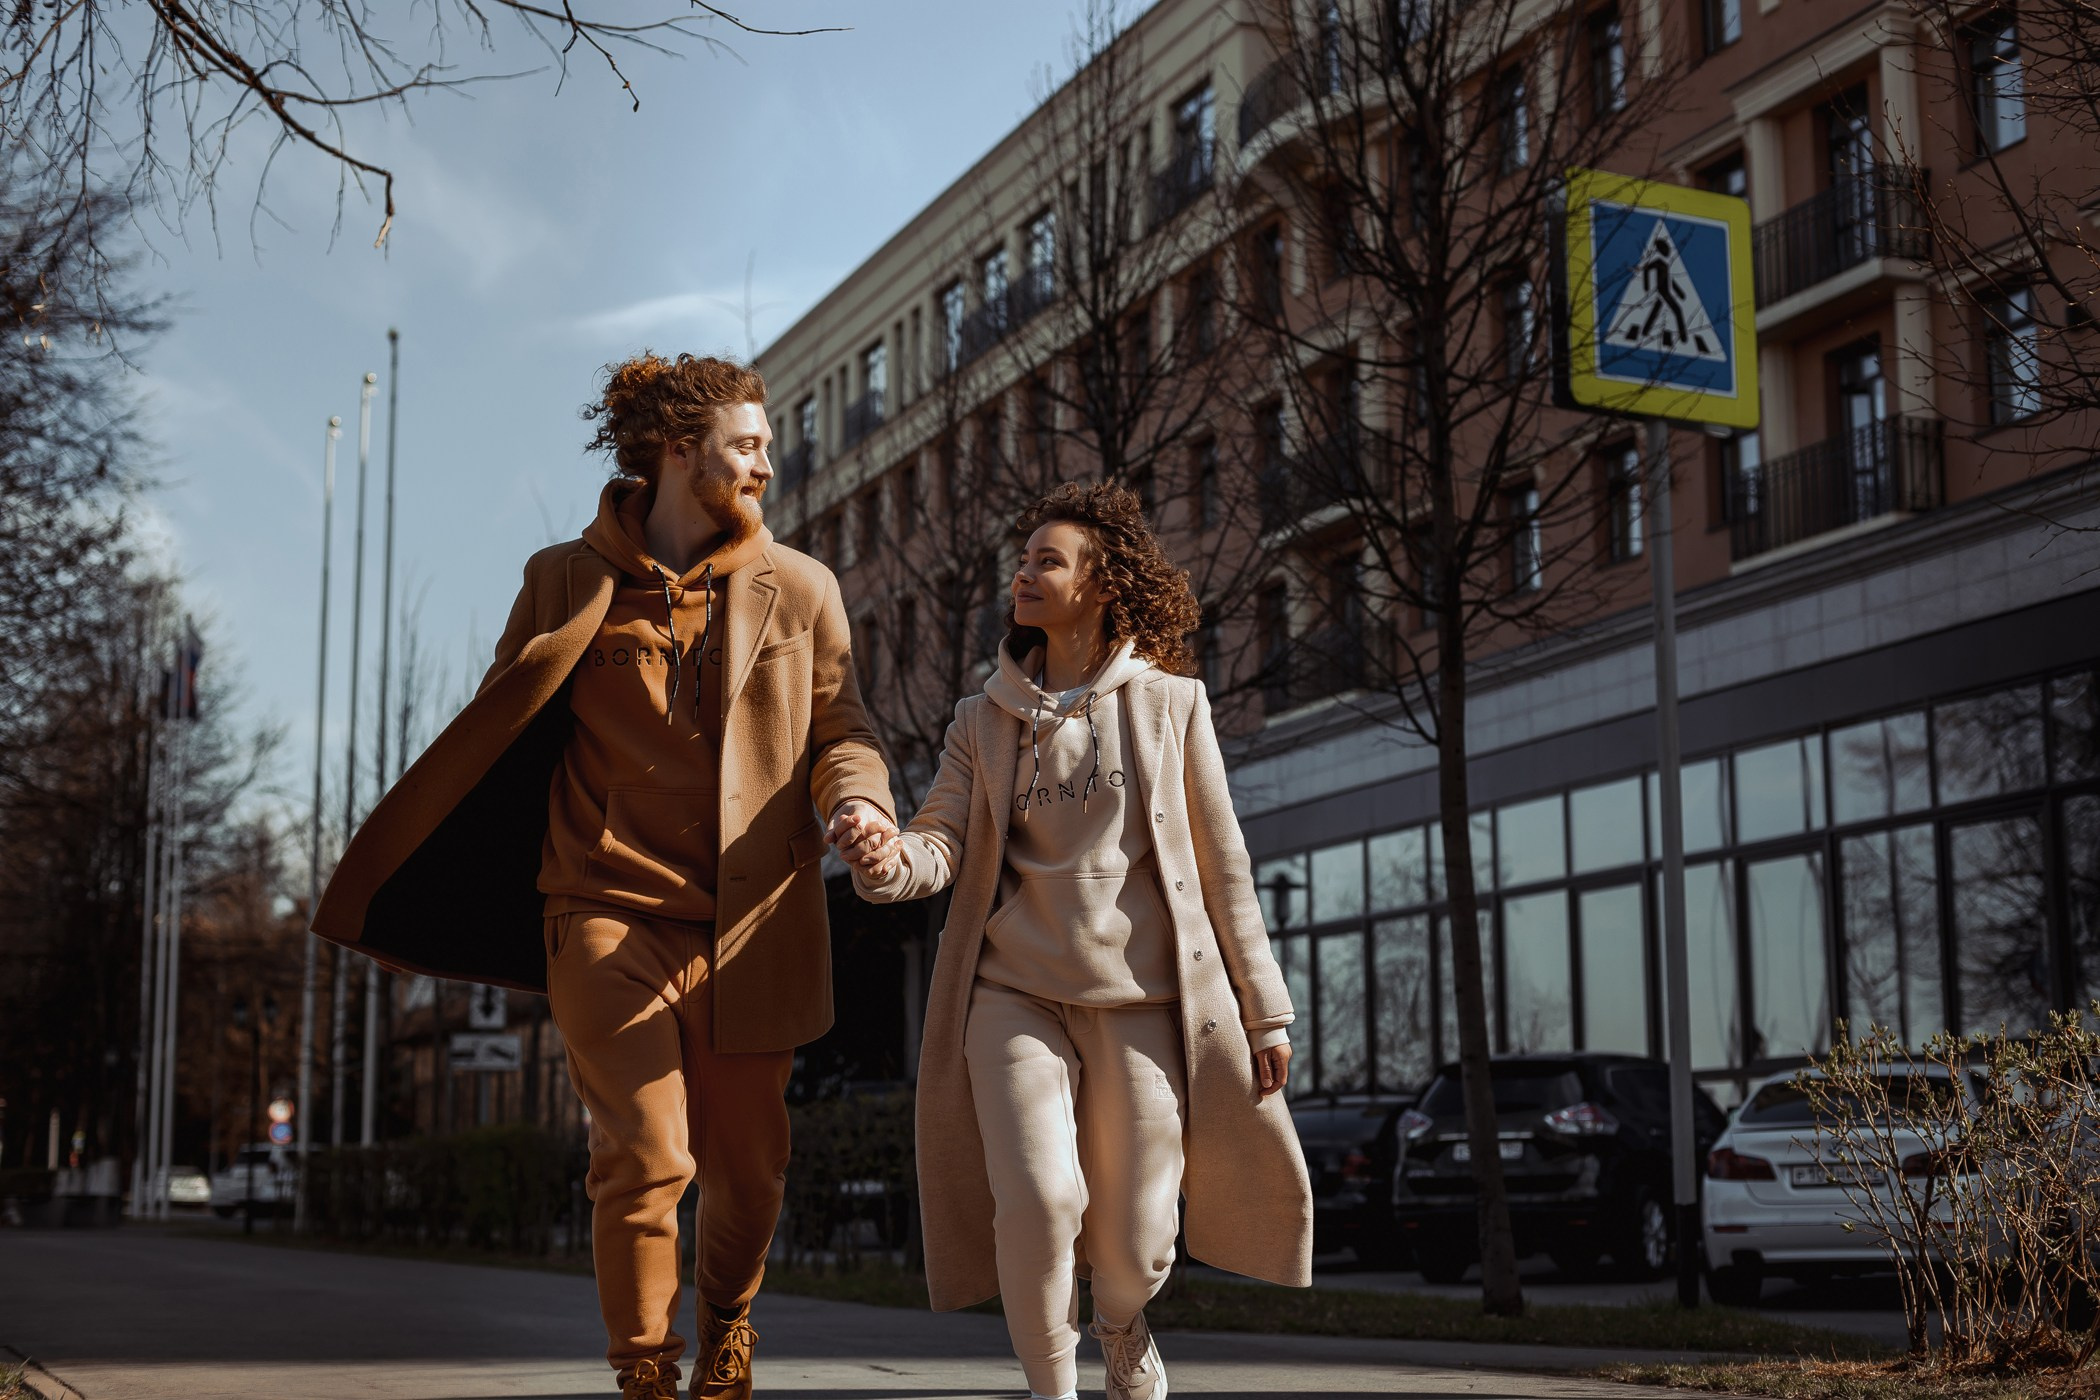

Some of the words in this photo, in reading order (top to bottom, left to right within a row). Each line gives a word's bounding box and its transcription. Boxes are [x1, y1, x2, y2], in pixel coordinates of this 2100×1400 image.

[594, 647, 675, 667] BORN
[689, 647, 722, 666] TO
[1087, 770, 1126, 793] TO
